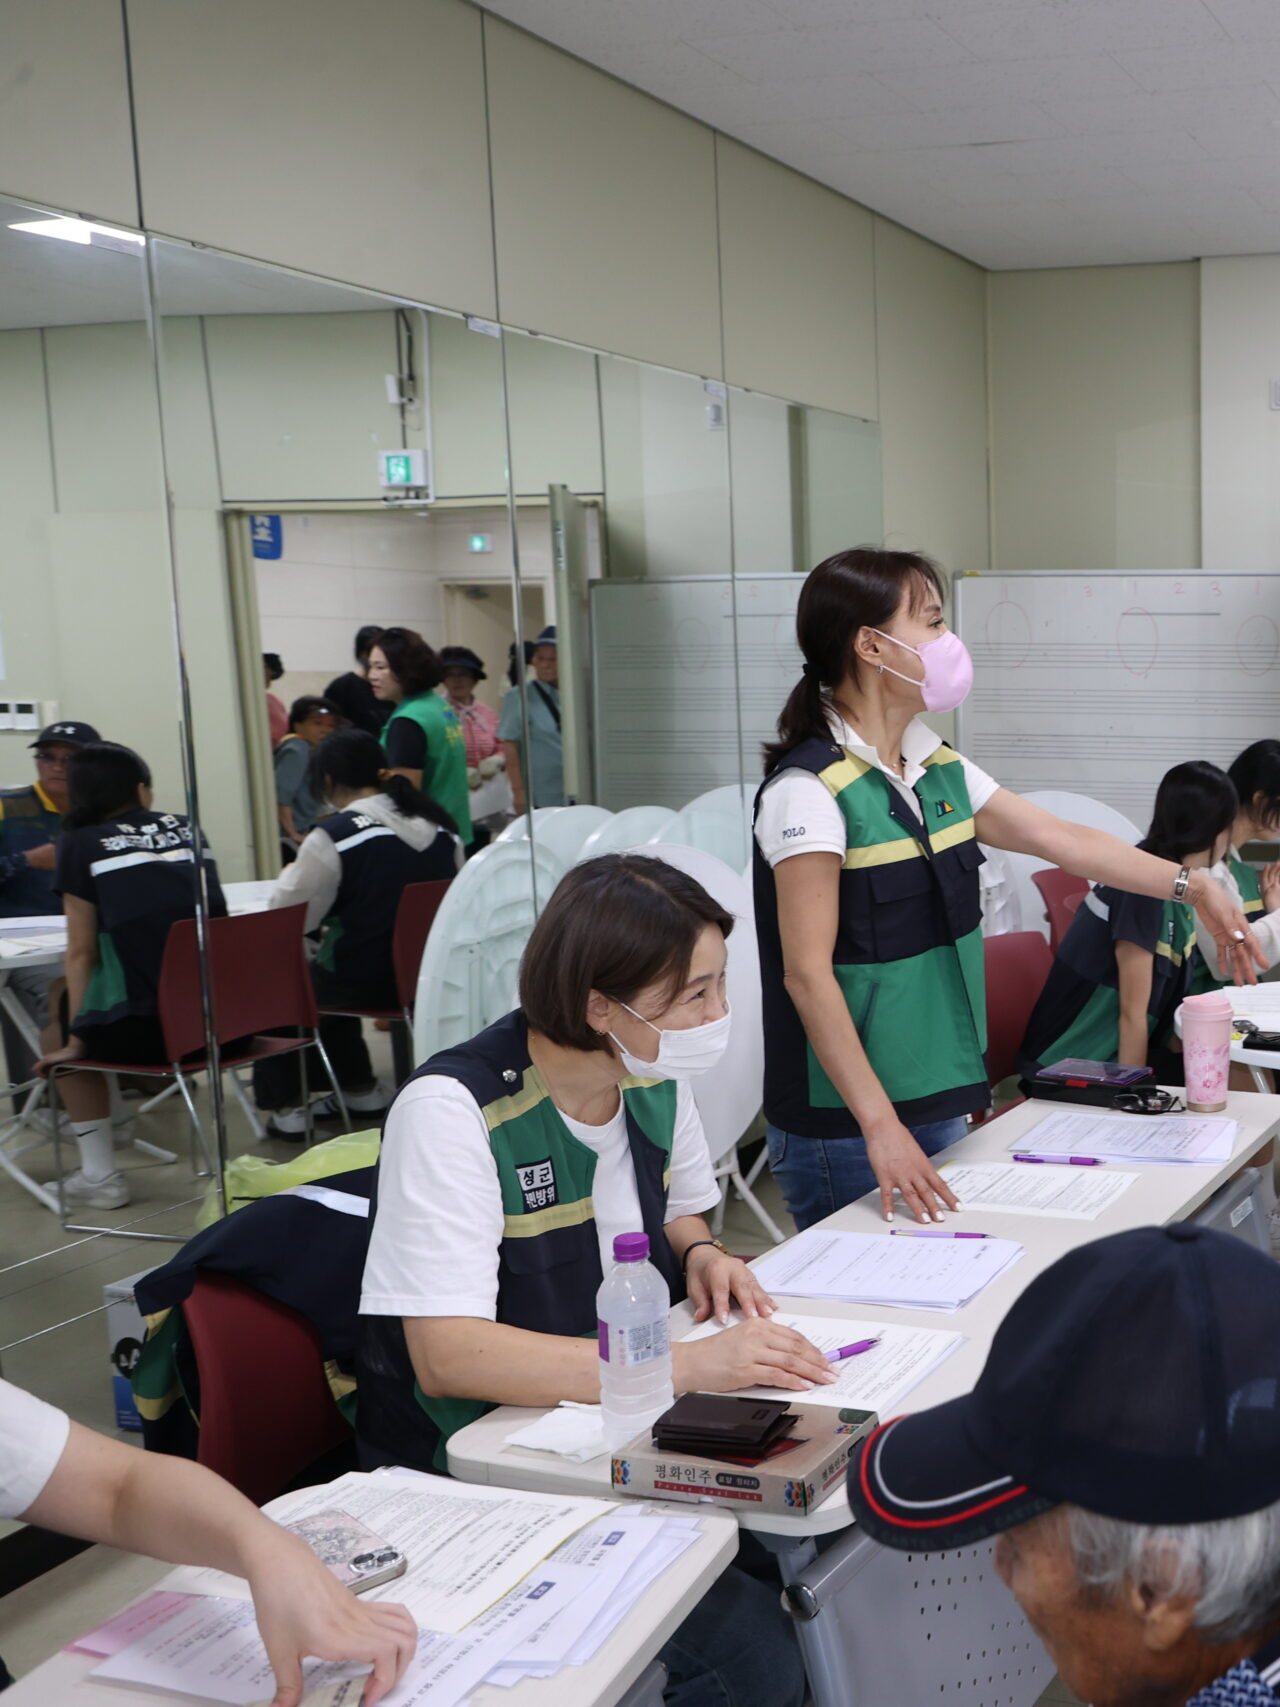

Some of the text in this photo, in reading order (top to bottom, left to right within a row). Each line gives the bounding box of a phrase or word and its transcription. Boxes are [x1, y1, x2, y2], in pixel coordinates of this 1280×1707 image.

[1174, 582, 1185, 594] 2
[1210, 581, 1222, 596] 3
[782, 826, 806, 840] POLO
[655, 1464, 712, 1484] 평화인주
